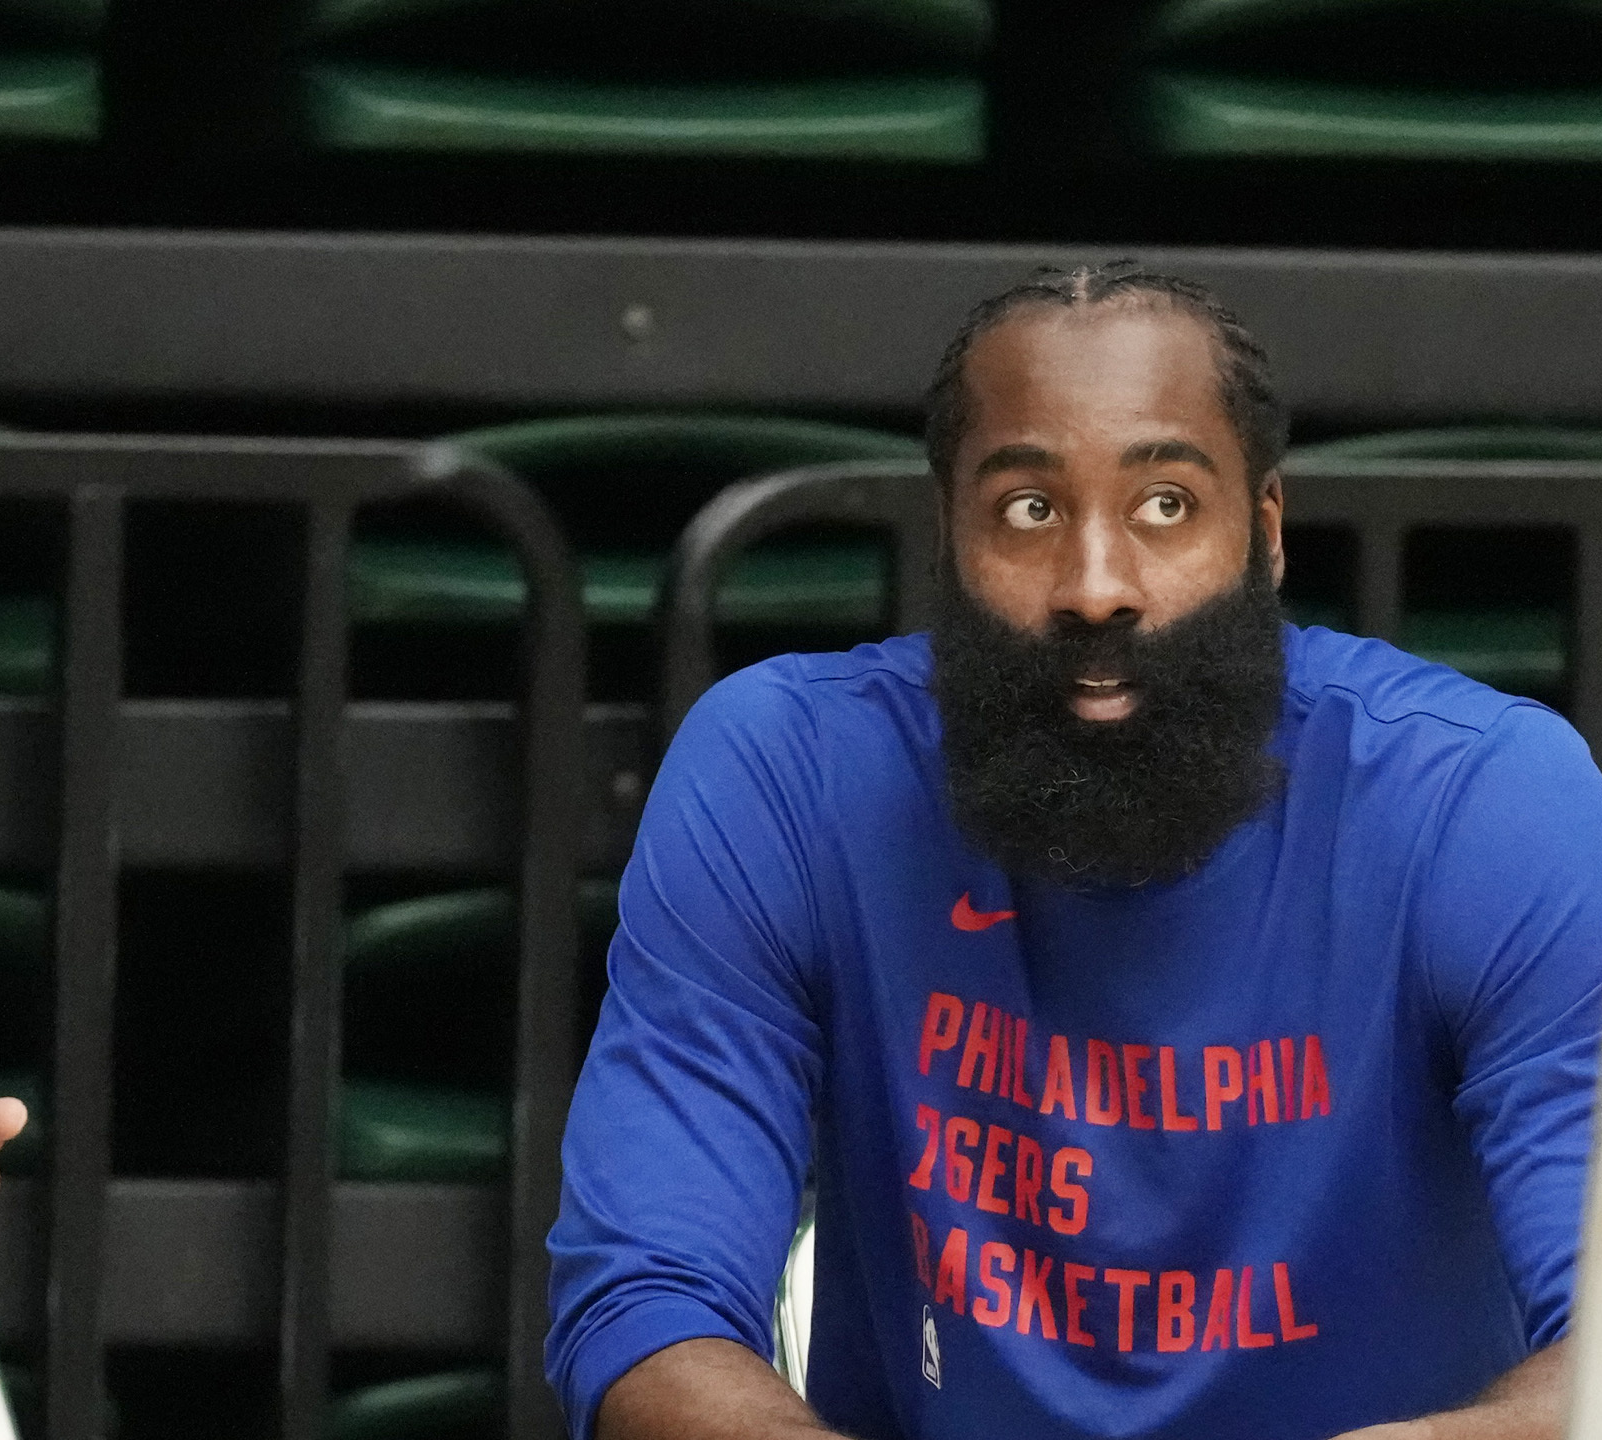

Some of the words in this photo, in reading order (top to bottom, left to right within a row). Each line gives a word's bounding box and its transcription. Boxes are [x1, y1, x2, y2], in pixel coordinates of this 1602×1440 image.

[918, 991, 1331, 1132] PHILADELPHIA
[908, 1103, 1093, 1235] 76ERS
[908, 1211, 1318, 1353] BASKETBALL
